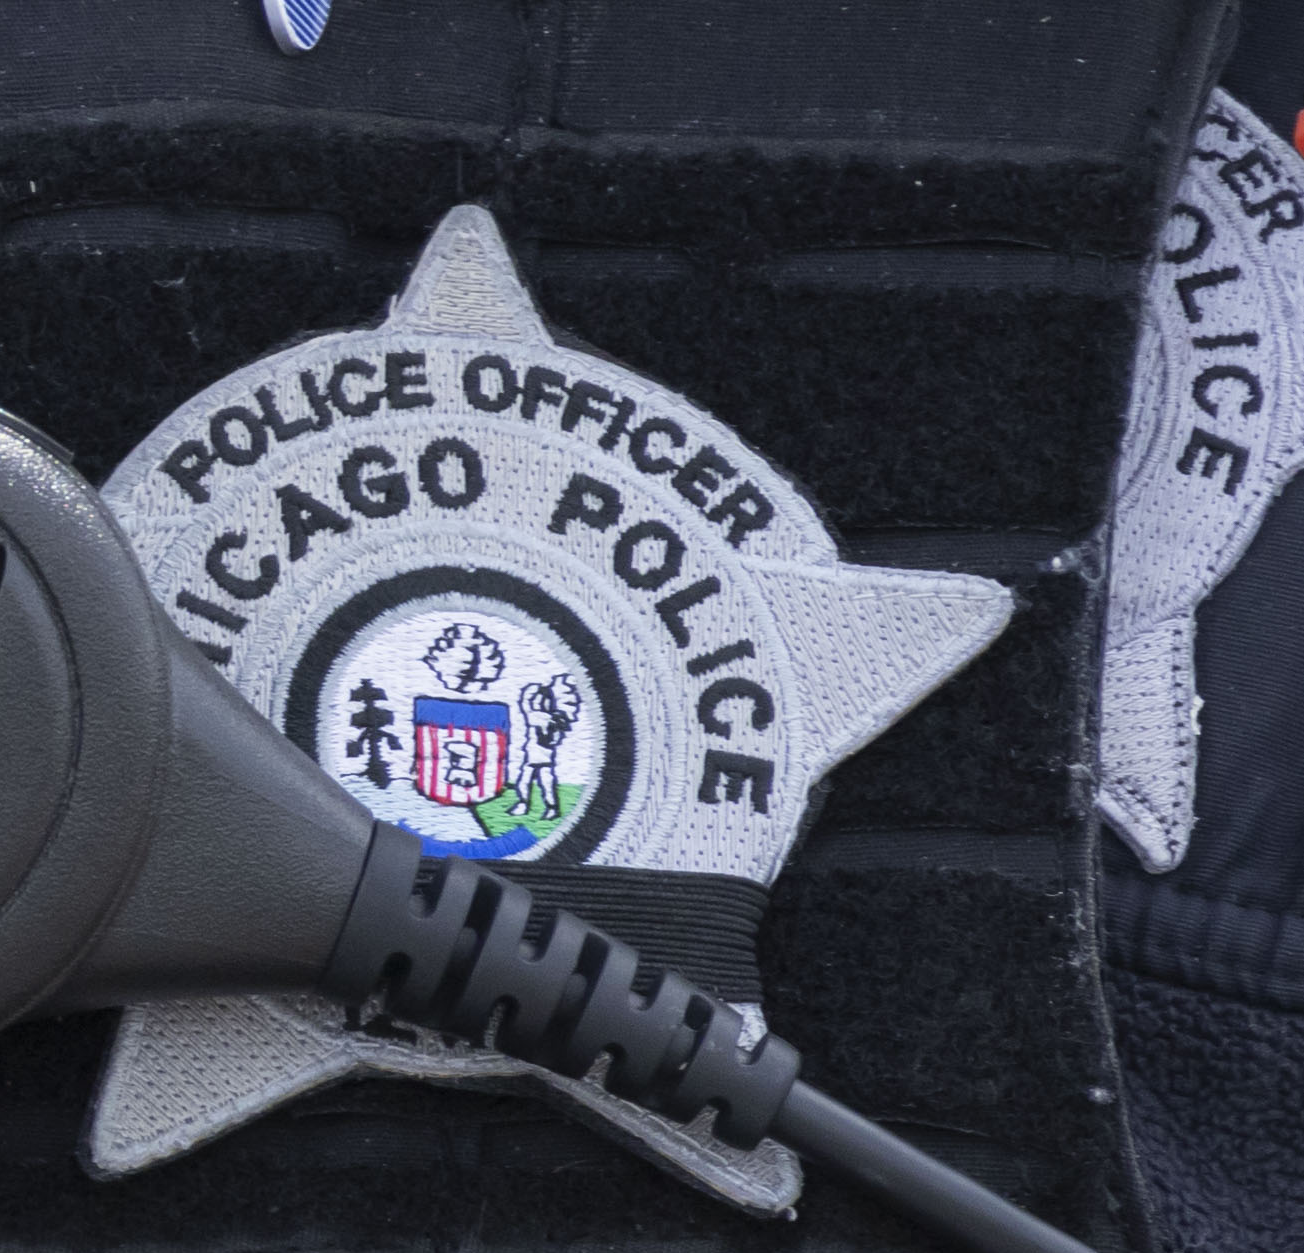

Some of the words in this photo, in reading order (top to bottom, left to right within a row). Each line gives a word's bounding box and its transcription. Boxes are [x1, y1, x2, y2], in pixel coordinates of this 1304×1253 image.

[157, 352, 434, 503] POLICE
[463, 355, 773, 547] OFFICER
[547, 473, 773, 814] POLICE
